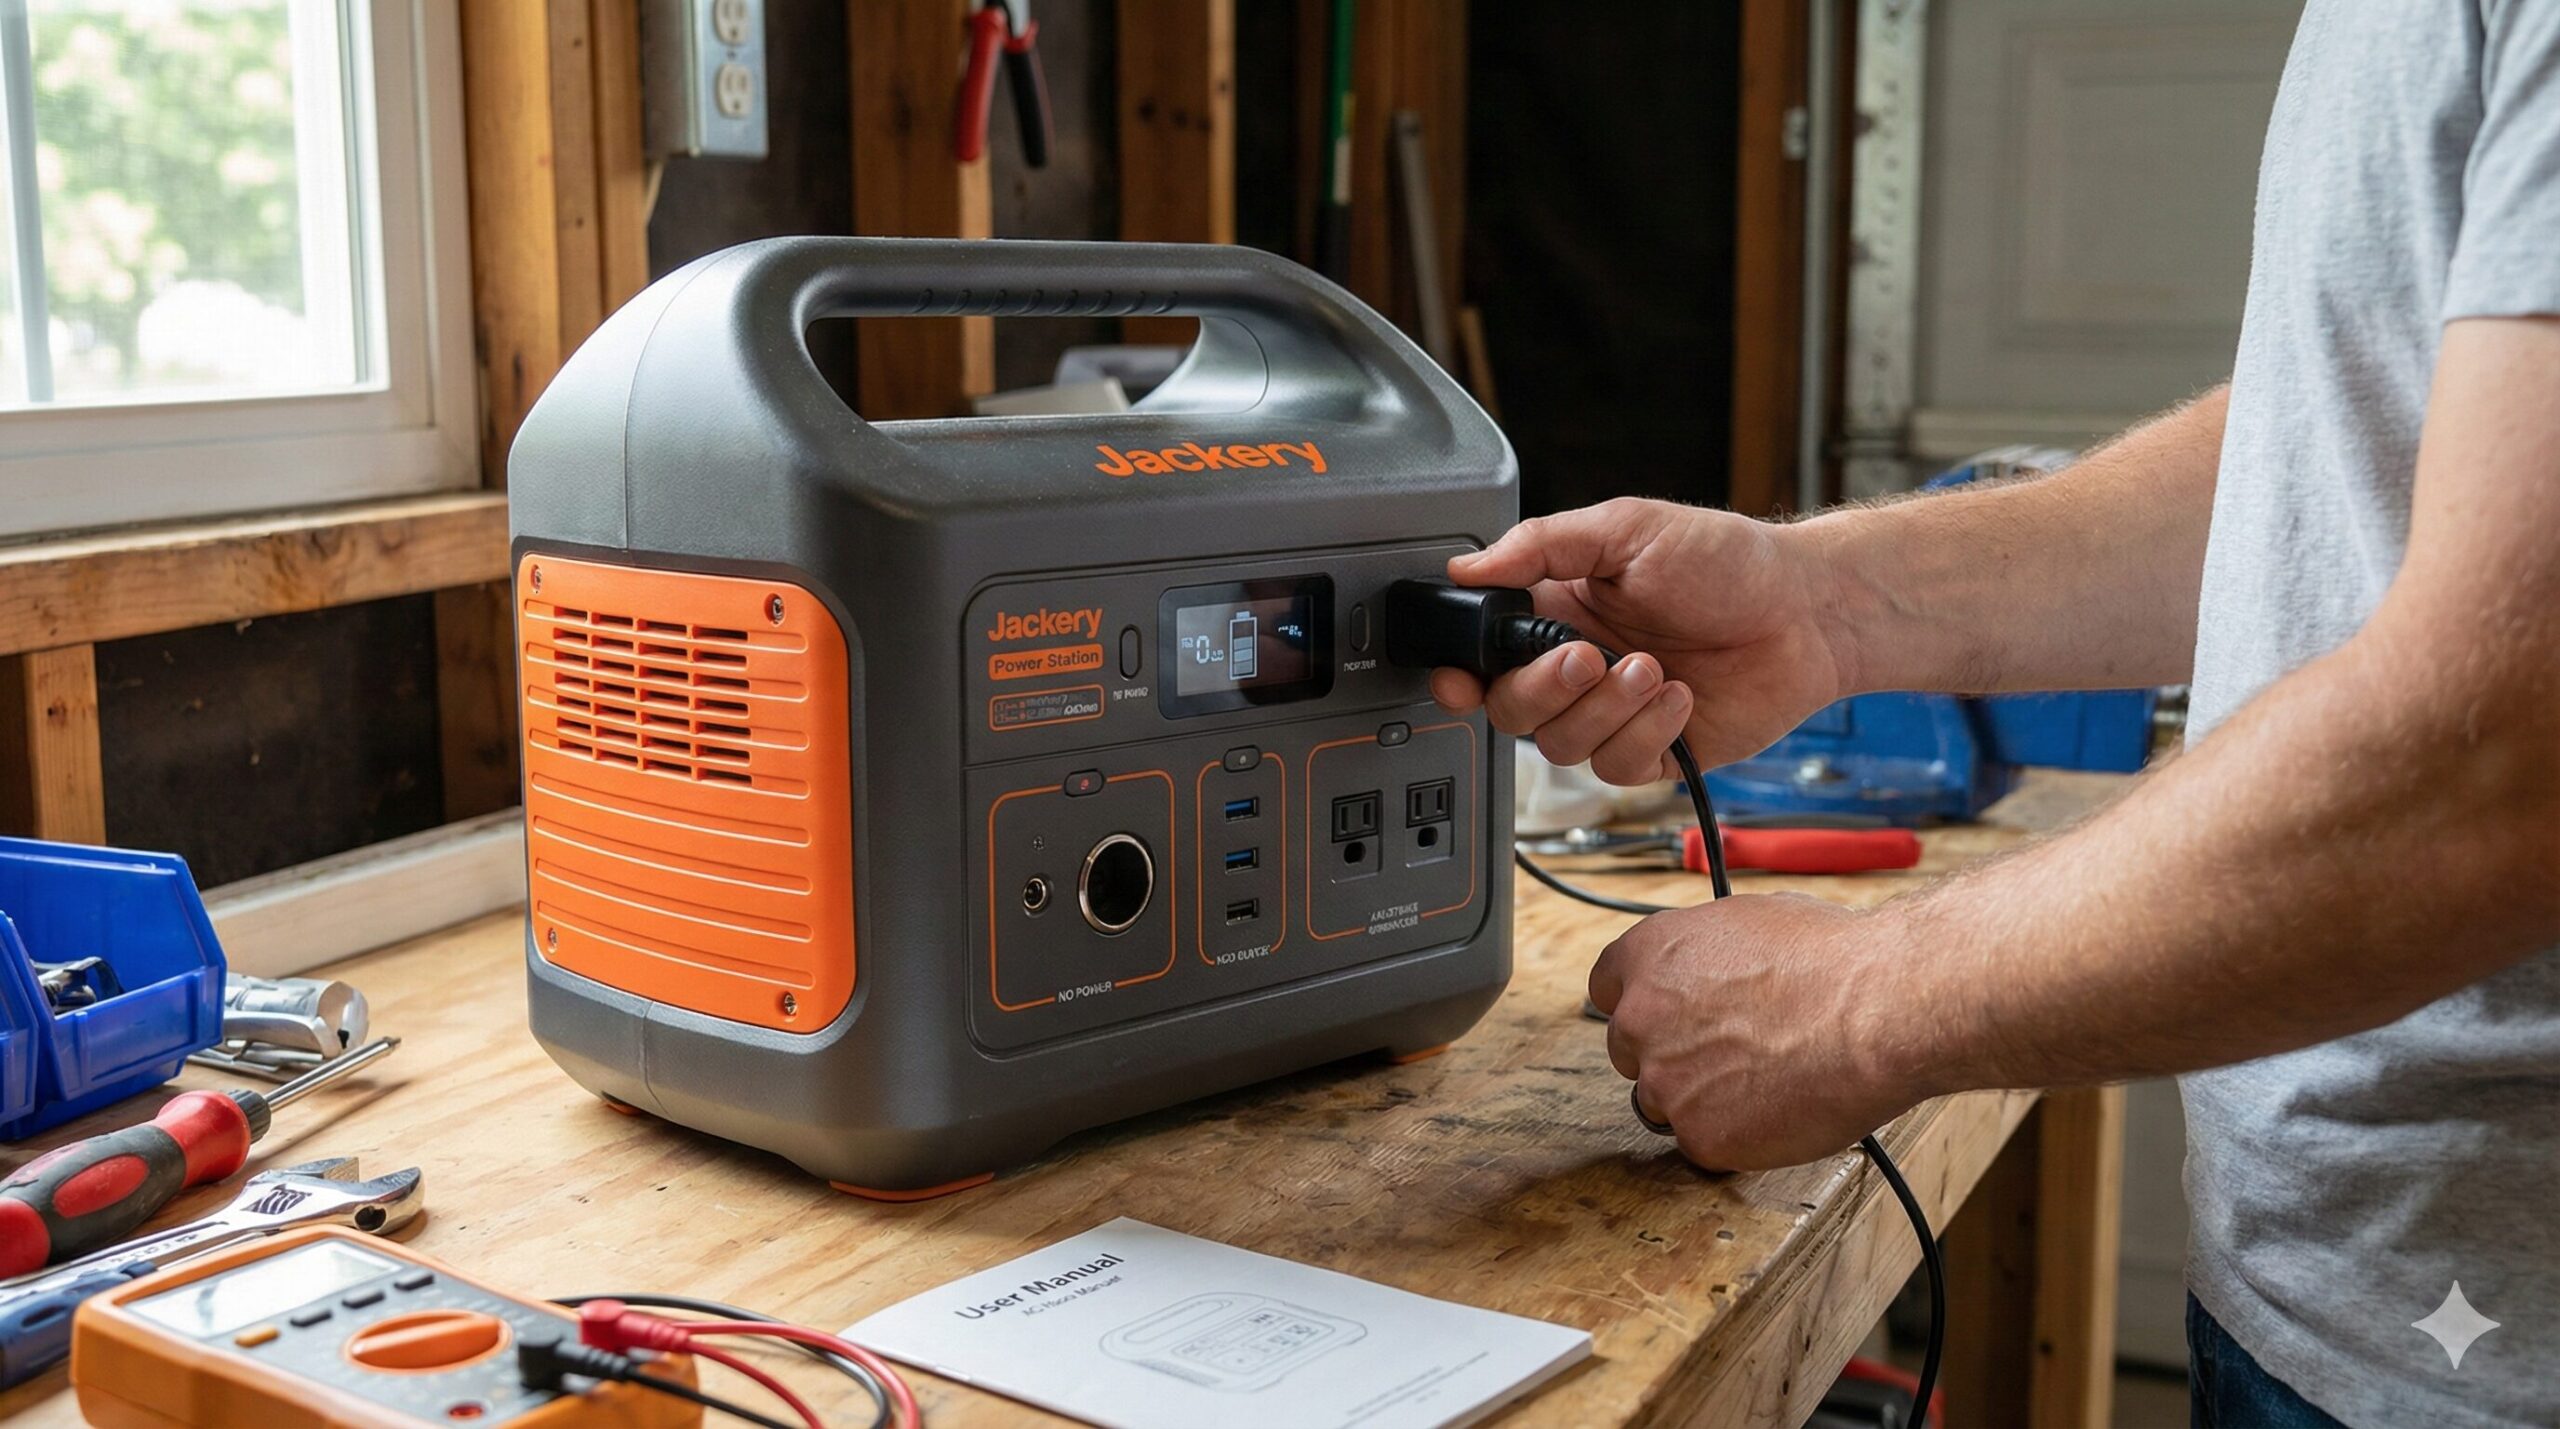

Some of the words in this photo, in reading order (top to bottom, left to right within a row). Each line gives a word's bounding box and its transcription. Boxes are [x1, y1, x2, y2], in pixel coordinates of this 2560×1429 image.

[1095, 442, 1327, 476] Jackery
[988, 608, 1103, 641] Jackery
[994, 657, 1043, 674] Power
[1047, 650, 1099, 668] Station
[954, 1292, 1024, 1320] User
[1020, 1253, 1125, 1296] Manual
